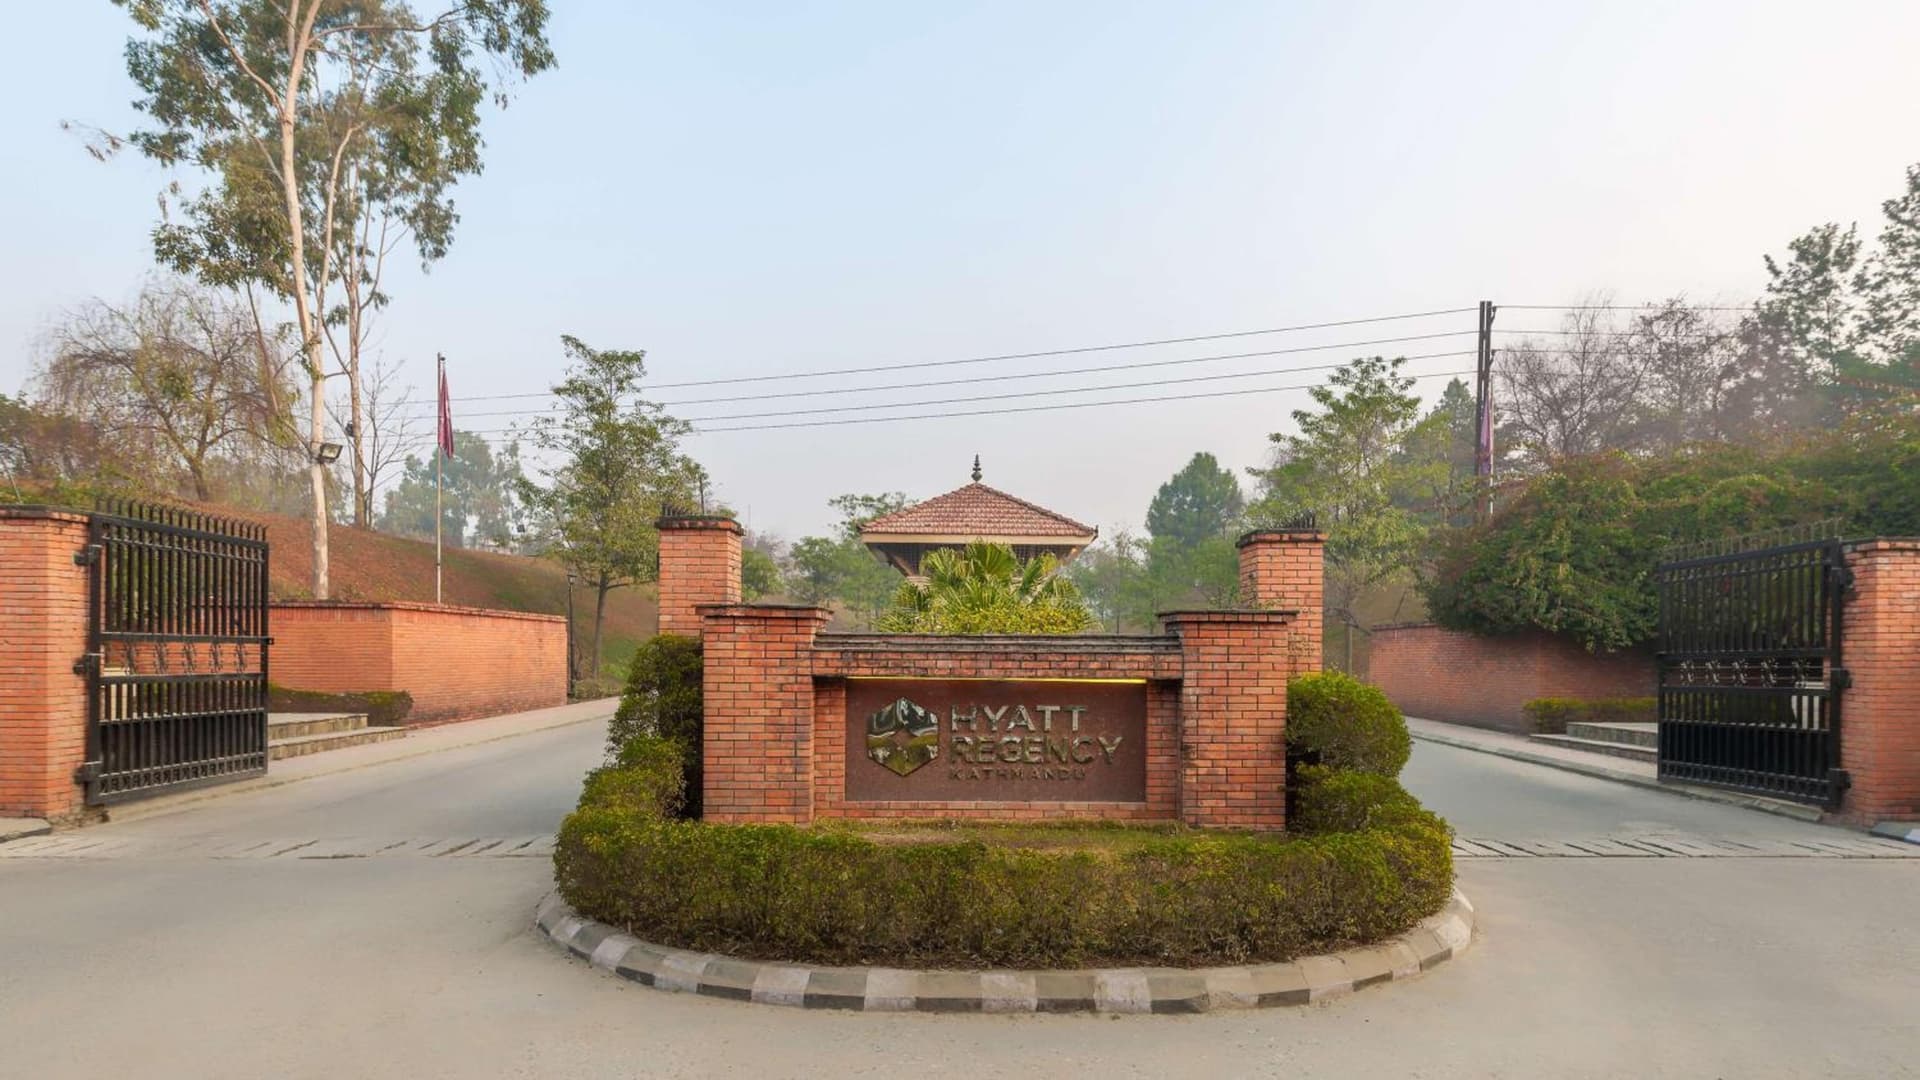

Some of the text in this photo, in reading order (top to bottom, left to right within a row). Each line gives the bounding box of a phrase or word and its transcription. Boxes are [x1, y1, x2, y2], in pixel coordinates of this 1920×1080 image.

[951, 704, 1087, 732] HYATT
[951, 736, 1123, 765] REGENCY
[951, 767, 1086, 780] KATHMANDU
